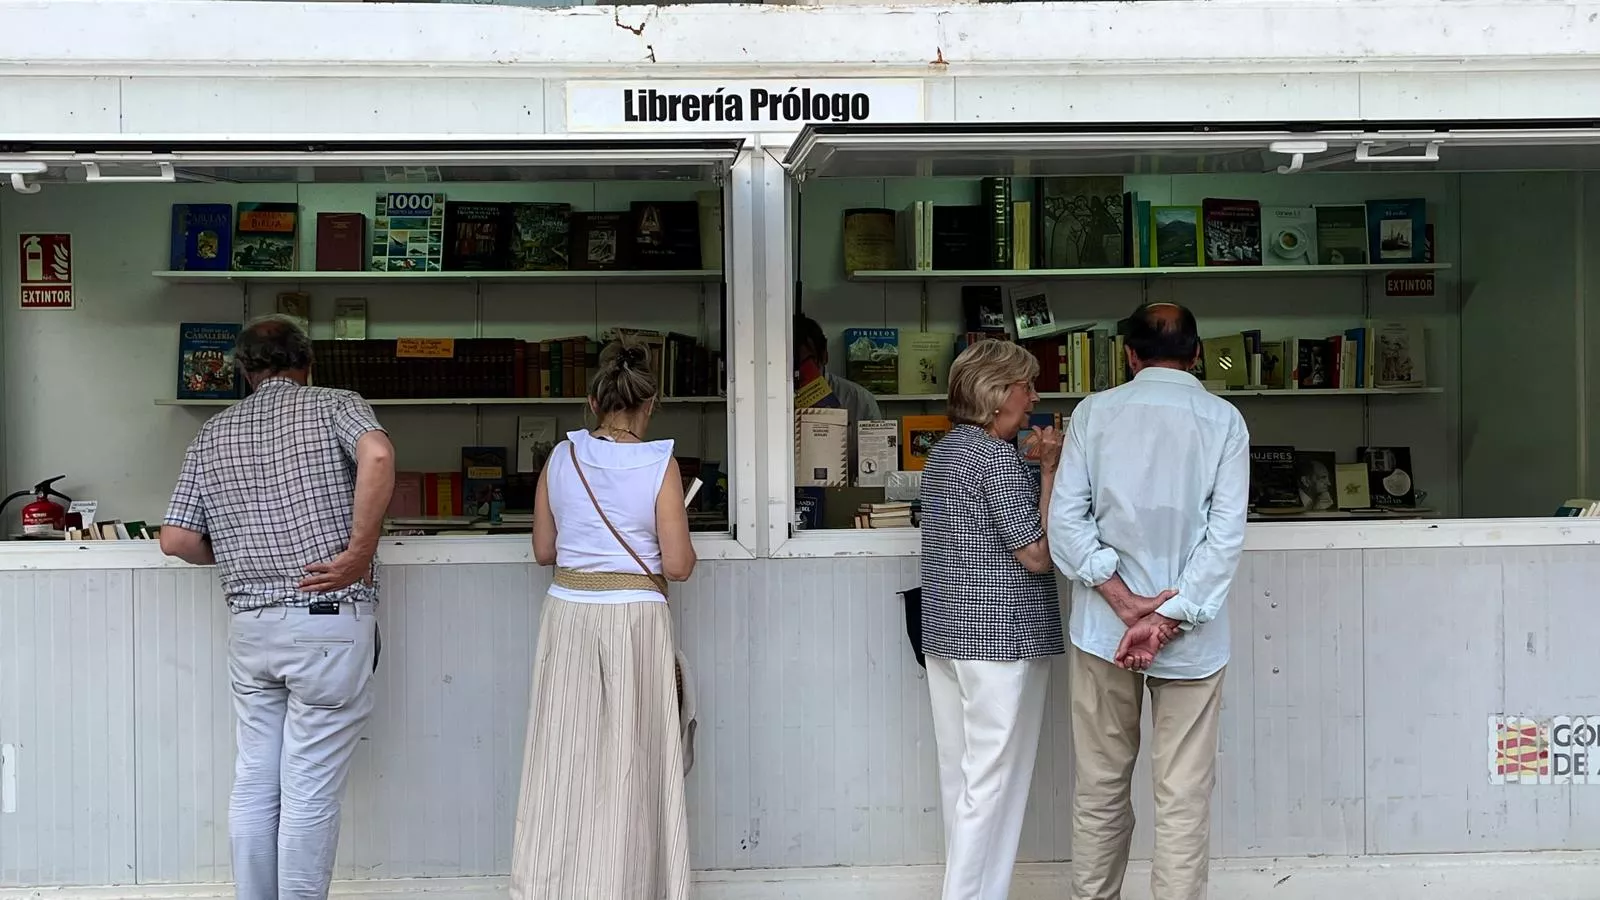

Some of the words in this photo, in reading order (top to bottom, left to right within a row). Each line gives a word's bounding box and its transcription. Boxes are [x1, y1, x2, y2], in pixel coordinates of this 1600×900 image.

[623, 87, 743, 122] Librería
[750, 87, 870, 122] Prólogo
[389, 194, 433, 210] 1000
[1387, 279, 1433, 292] EXTINTOR
[22, 290, 71, 303] EXTINTOR
[1553, 724, 1600, 748] GO
[1553, 754, 1590, 775] DE
